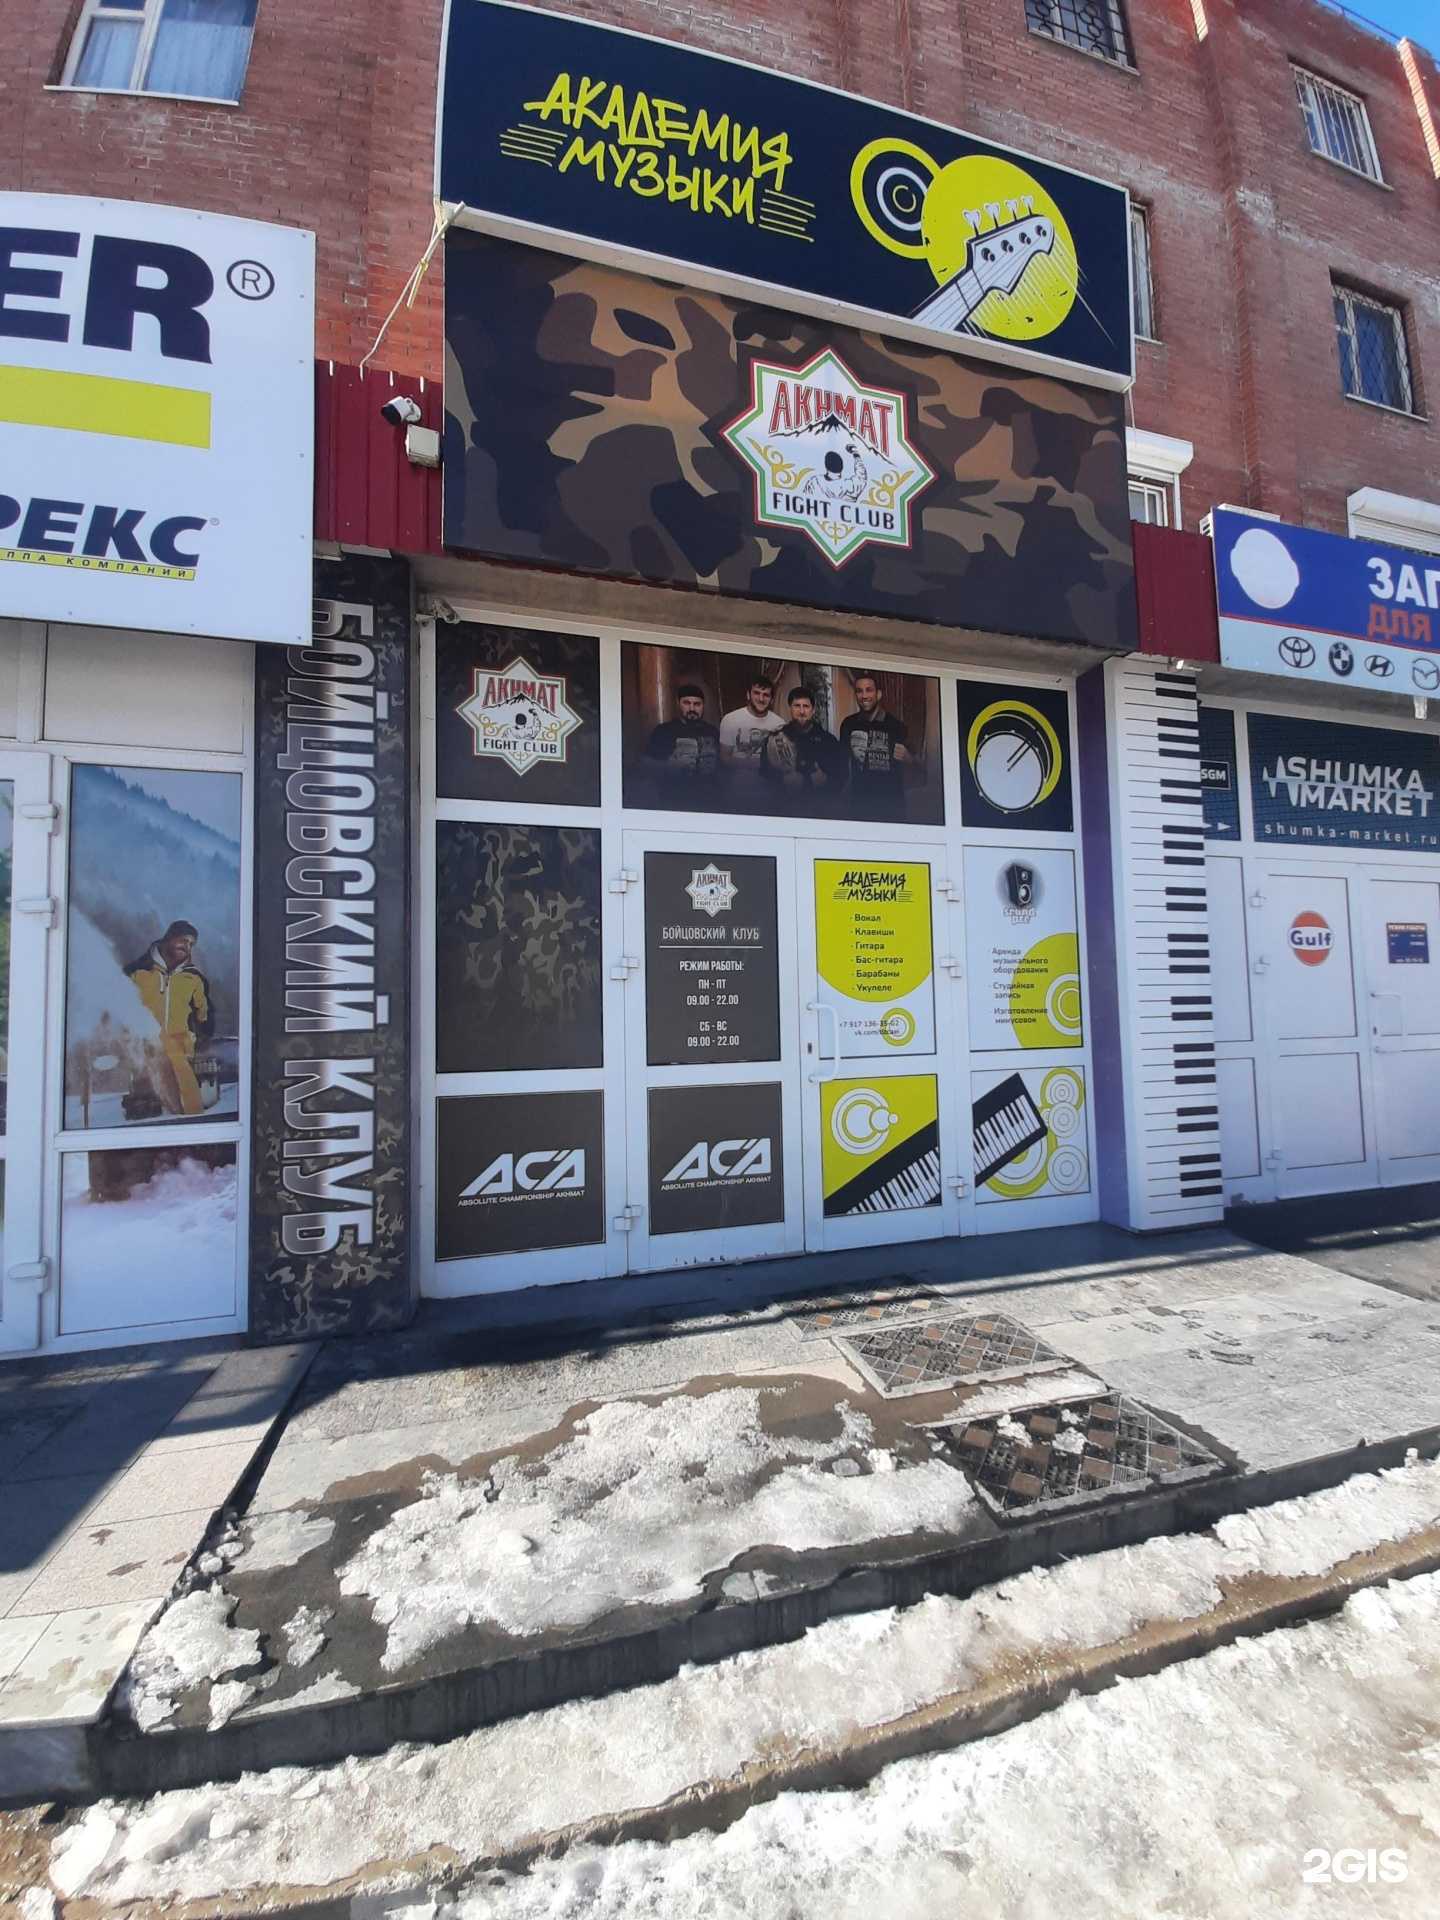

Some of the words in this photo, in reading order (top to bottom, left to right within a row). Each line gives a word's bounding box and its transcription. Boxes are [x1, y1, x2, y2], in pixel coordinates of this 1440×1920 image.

[523, 73, 792, 191] АКАДЕМИЯ
[558, 136, 755, 224] МУЗЫКИ
[0, 226, 214, 364] ER
[768, 379, 893, 457] AKHMAT
[772, 491, 831, 519] FIGHT
[840, 504, 895, 530] CLUB
[66, 557, 187, 578] КОМПАНИЙ
[1367, 603, 1433, 643] ДЛЯ
[481, 676, 559, 714] AKHMAT
[482, 738, 519, 751] FIGHT
[523, 741, 558, 754] CLUB
[1200, 767, 1227, 781] SGM
[1287, 756, 1425, 793] SHUMKA
[1299, 781, 1434, 817] MARKET
[277, 599, 389, 1033] БОЙЦОВСКИЙ
[1264, 822, 1437, 845] shumka-market.ru
[838, 871, 907, 891] АКАДЕМИЯ
[847, 888, 898, 902] МУЗЫКИ
[854, 913, 882, 922] Вокал
[662, 925, 726, 940] БОЙЦОВСКИЙ
[733, 927, 760, 940] КЛУБ
[855, 927, 895, 936] Клавиши
[1290, 930, 1331, 946] Gulf
[855, 941, 885, 950] Гитара
[679, 961, 709, 971] РЕЖИМ
[711, 961, 745, 971] РАБОТЫ:
[855, 955, 904, 965] Бас-гитара
[856, 969, 900, 979] Барабаны
[698, 979, 710, 989] ПН
[716, 979, 727, 989] ПТ
[856, 984, 892, 993] Укулеле
[686, 995, 710, 1006] 09.00
[716, 994, 739, 1005] 22.00
[699, 1021, 710, 1032] СБ
[716, 1020, 728, 1031] ВС
[687, 1036, 711, 1047] 09.00
[717, 1035, 740, 1046] 22.00
[281, 1058, 375, 1255] КЛУБ
[661, 1137, 772, 1182] ACA
[458, 1148, 585, 1197] ACA
[660, 1181, 696, 1192] ABSOLUTE
[457, 1196, 499, 1207] ABSOLUTE
[499, 1193, 555, 1204] CHAMPIONSHIP
[555, 1189, 585, 1198] AKHMAT
